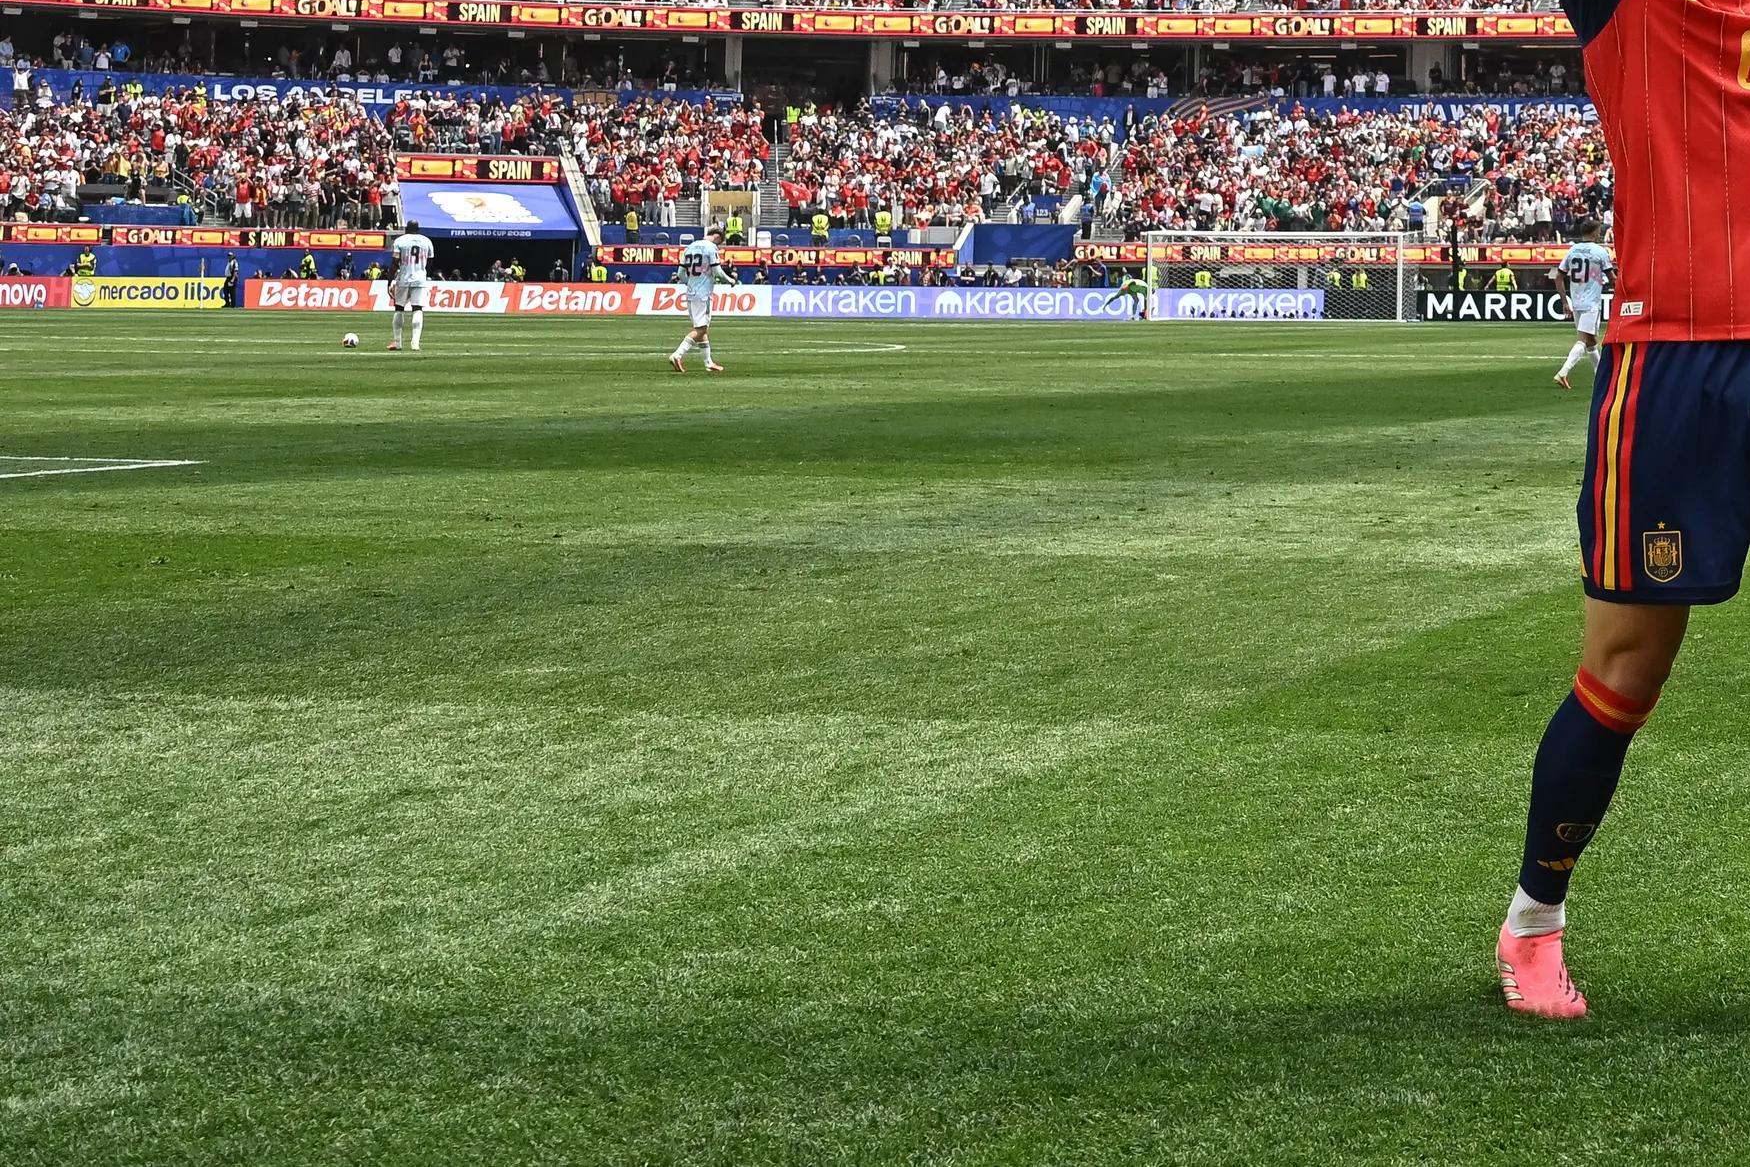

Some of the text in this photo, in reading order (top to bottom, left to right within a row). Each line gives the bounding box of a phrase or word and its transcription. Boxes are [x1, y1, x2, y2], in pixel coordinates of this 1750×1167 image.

[459, 3, 500, 23] SPAIN
[584, 7, 641, 27] GOAL!
[742, 11, 782, 31] SPAIN
[935, 15, 990, 34] GOAL!
[1086, 17, 1126, 35] SPAIN
[1275, 16, 1330, 35] GOAL!
[1427, 17, 1466, 35] SPAIN
[214, 84, 277, 102] LOS
[489, 161, 531, 180] SPAIN
[128, 229, 173, 245] GOAL!
[248, 230, 286, 247] SPAIN
[622, 247, 655, 262] SPAIN
[773, 249, 817, 263] GOAL!
[892, 250, 922, 265] SPAIN
[1075, 244, 1118, 259] GOAL!
[1190, 246, 1221, 261] SPAIN
[1336, 246, 1378, 261] GOAL!
[1570, 257, 1590, 283] 21
[99, 282, 178, 301] mercado
[259, 282, 358, 307] Betano
[428, 285, 490, 309] tano
[520, 285, 621, 310] Betano
[652, 287, 756, 312] Beno
[808, 290, 917, 314] kraken
[1208, 291, 1316, 316] kraken
[1427, 293, 1614, 319] MARRIOT
